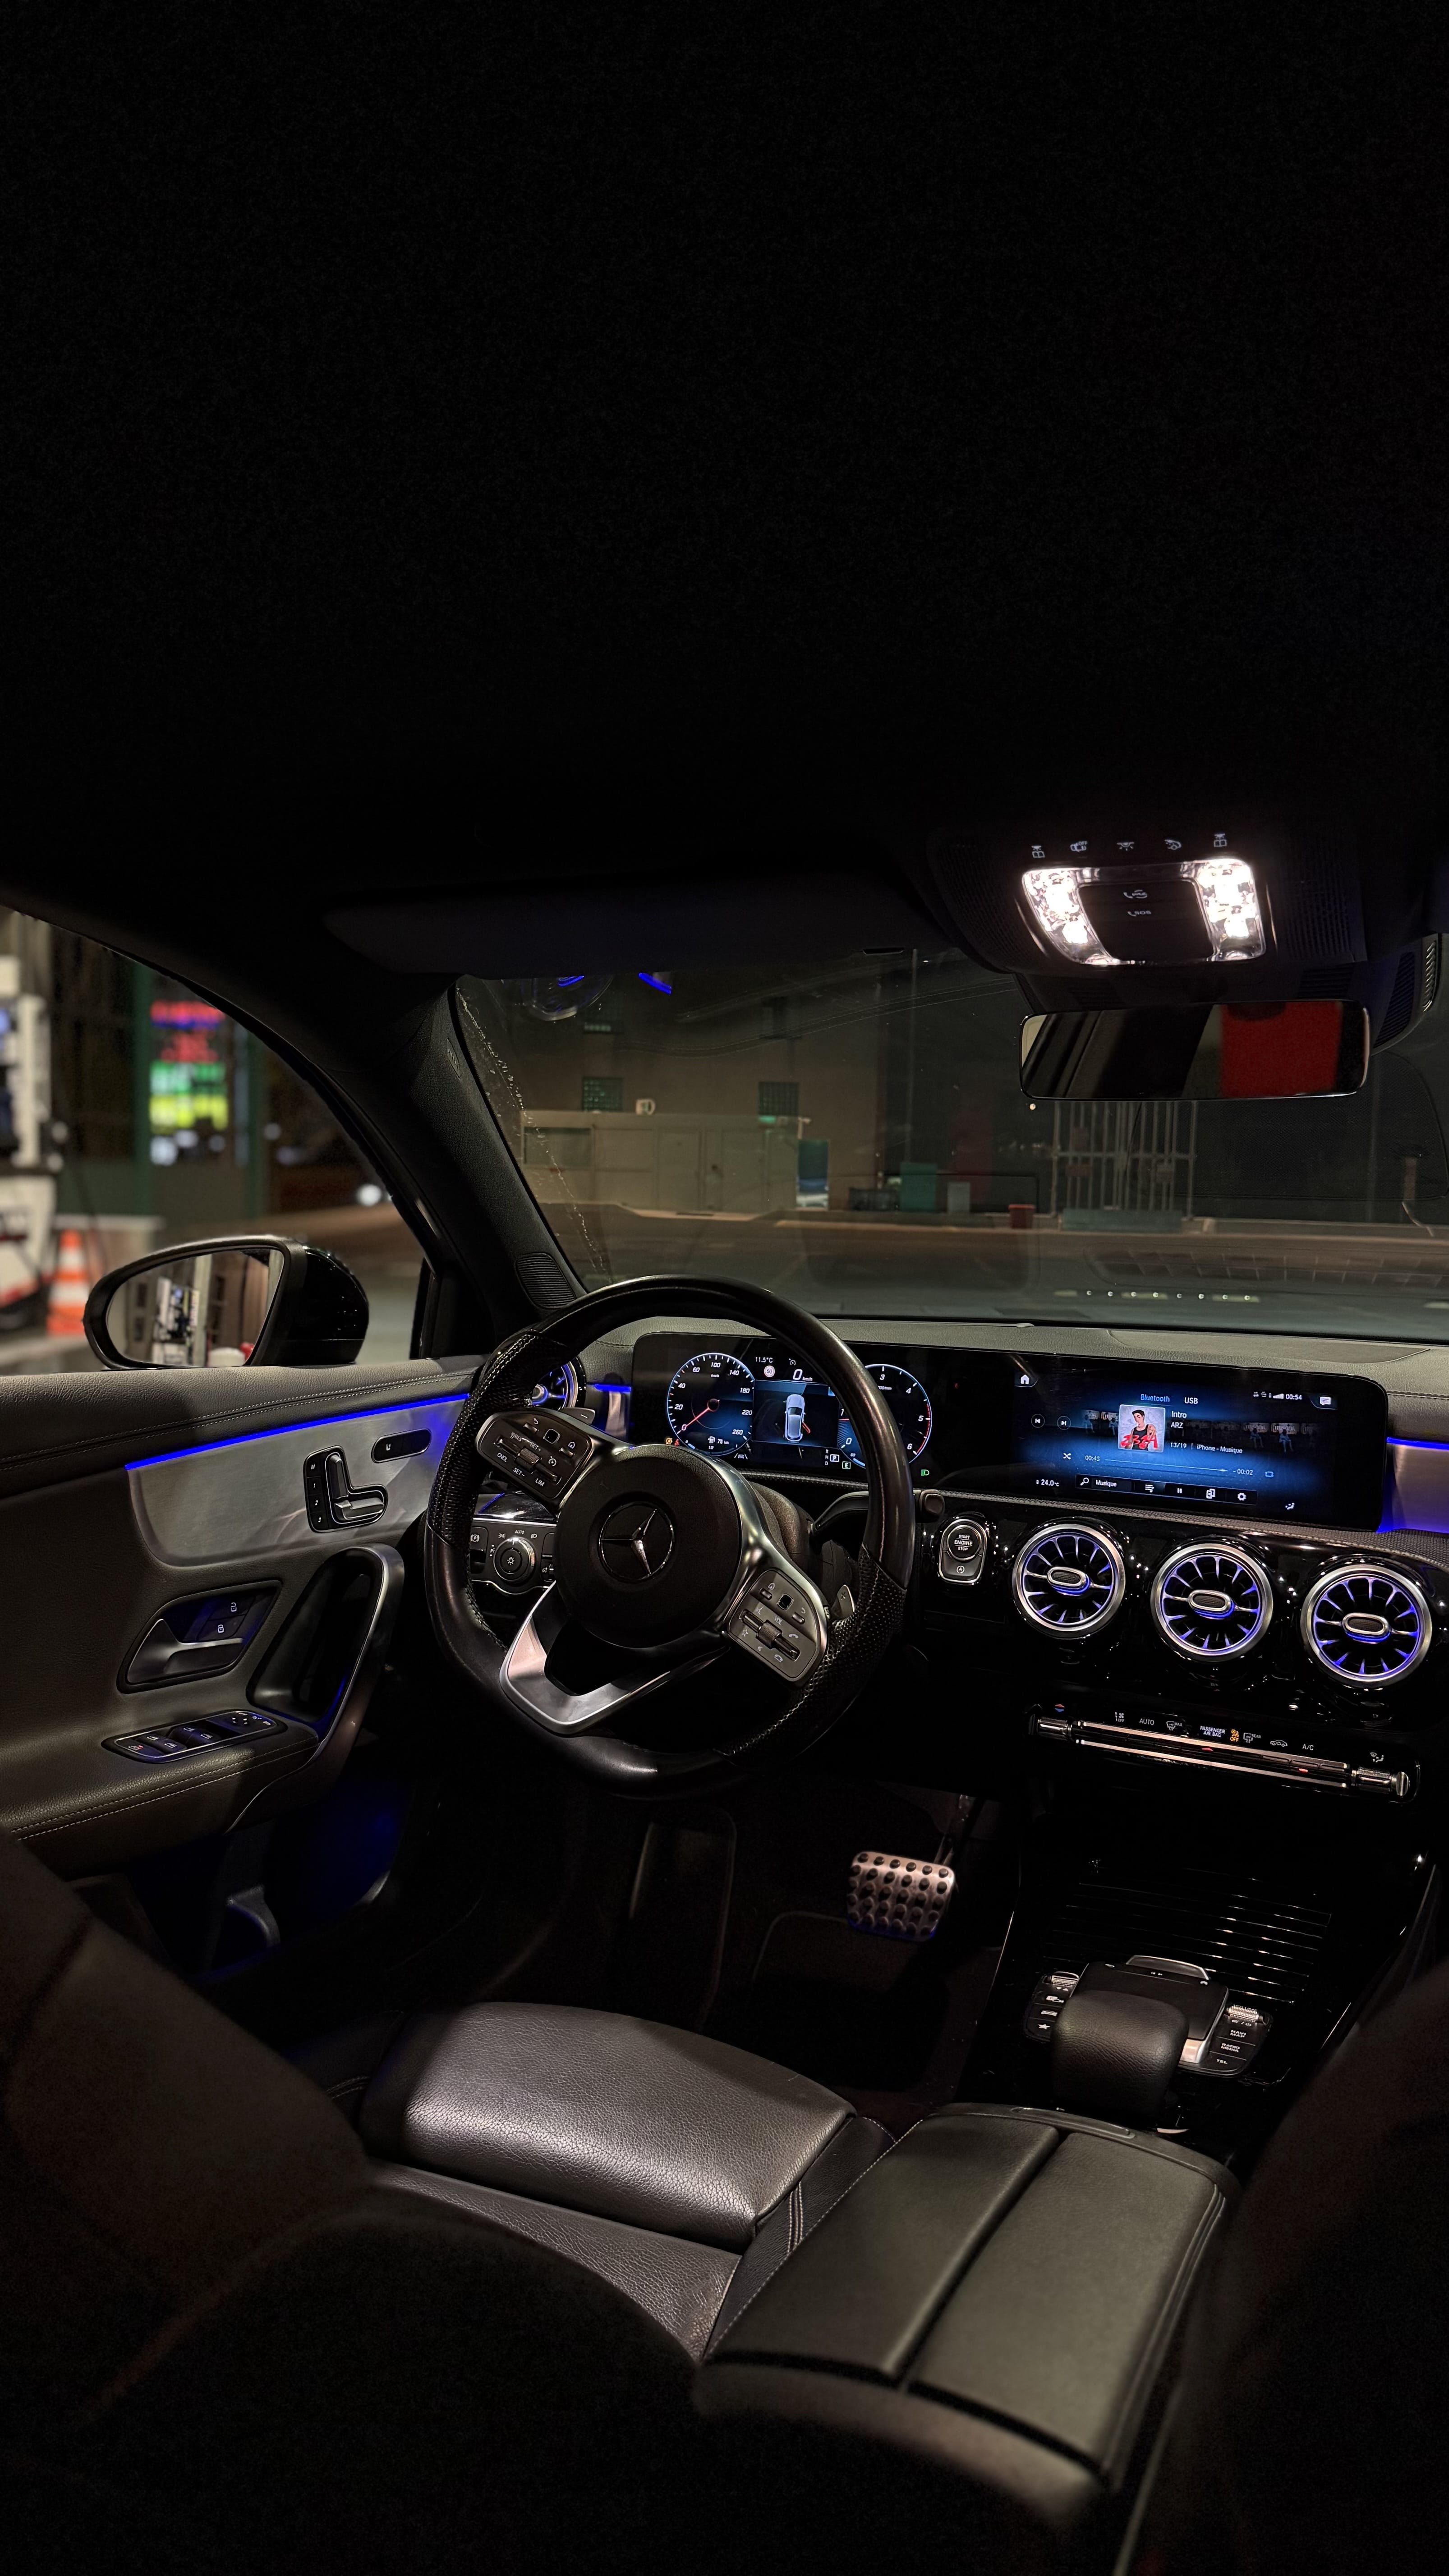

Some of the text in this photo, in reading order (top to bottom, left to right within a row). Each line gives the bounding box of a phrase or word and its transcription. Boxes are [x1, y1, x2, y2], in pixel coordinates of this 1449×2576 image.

[793, 1369, 802, 1380] 0
[1141, 1394, 1170, 1402] Bluetooth
[535, 1478, 545, 1487] LIM
[1095, 1479, 1117, 1487] Musique
[774, 1616, 782, 1625] VOL
[1200, 1725, 1225, 1734] PASSENGER
